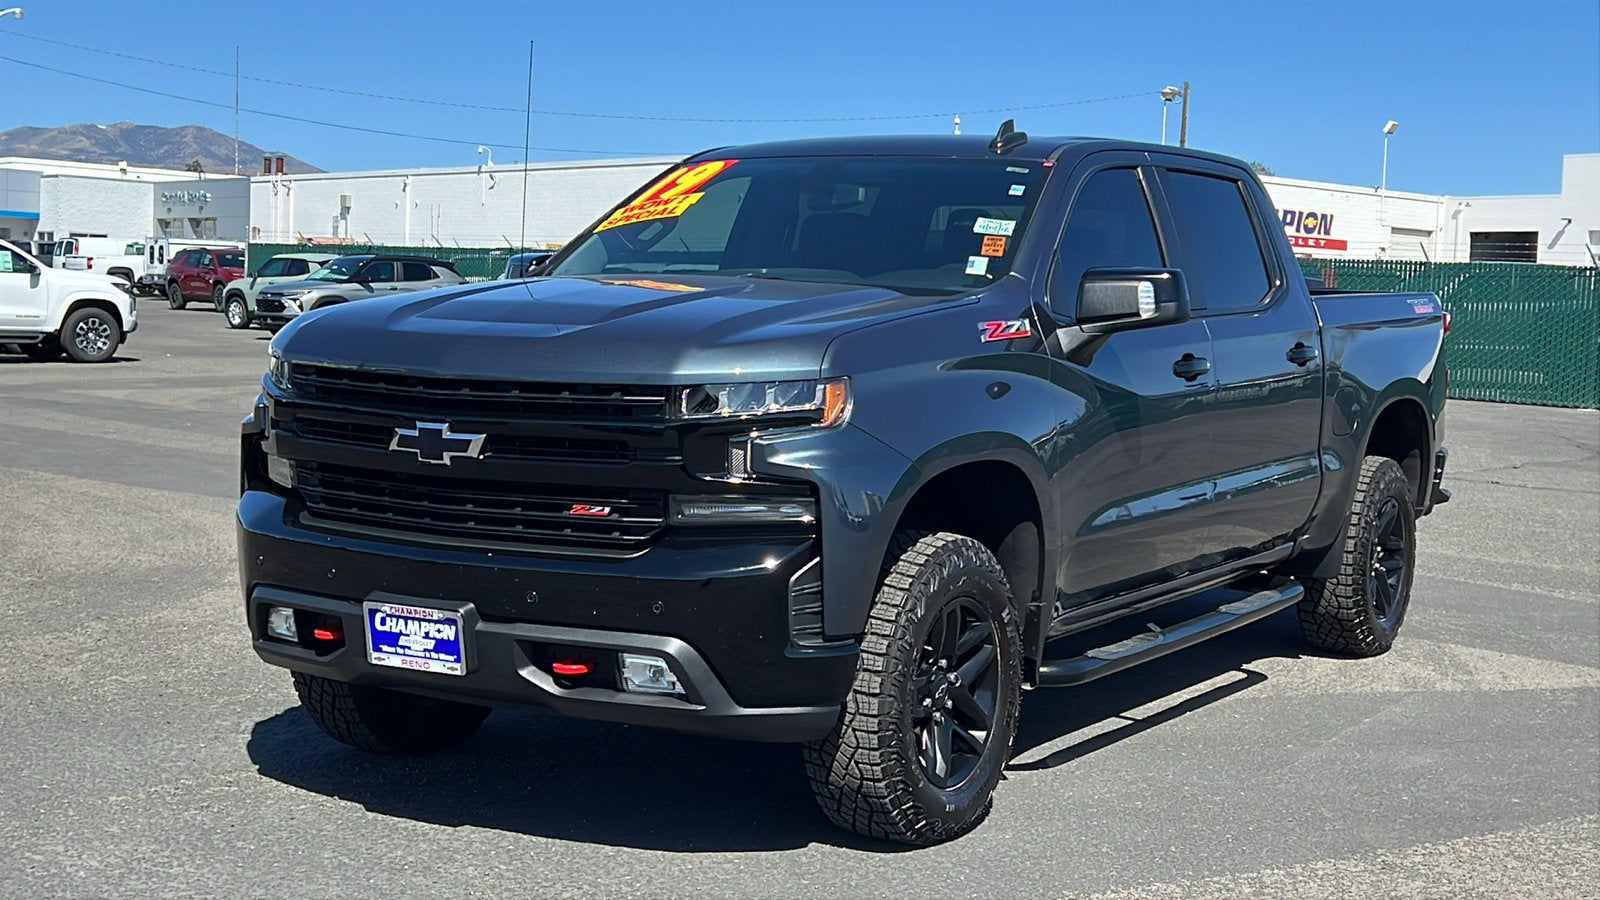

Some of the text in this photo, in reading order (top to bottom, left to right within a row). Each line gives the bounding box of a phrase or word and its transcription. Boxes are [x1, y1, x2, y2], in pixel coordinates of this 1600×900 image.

[630, 161, 726, 205] 19
[602, 206, 678, 228] SPECIAL
[1276, 209, 1334, 236] PION
[978, 319, 1031, 343] Z71
[569, 504, 611, 516] Z71
[389, 606, 434, 618] CHAMPION
[374, 612, 456, 641] CHAMPION
[401, 636, 433, 646] CHEVROLET
[401, 659, 431, 669] RENO
